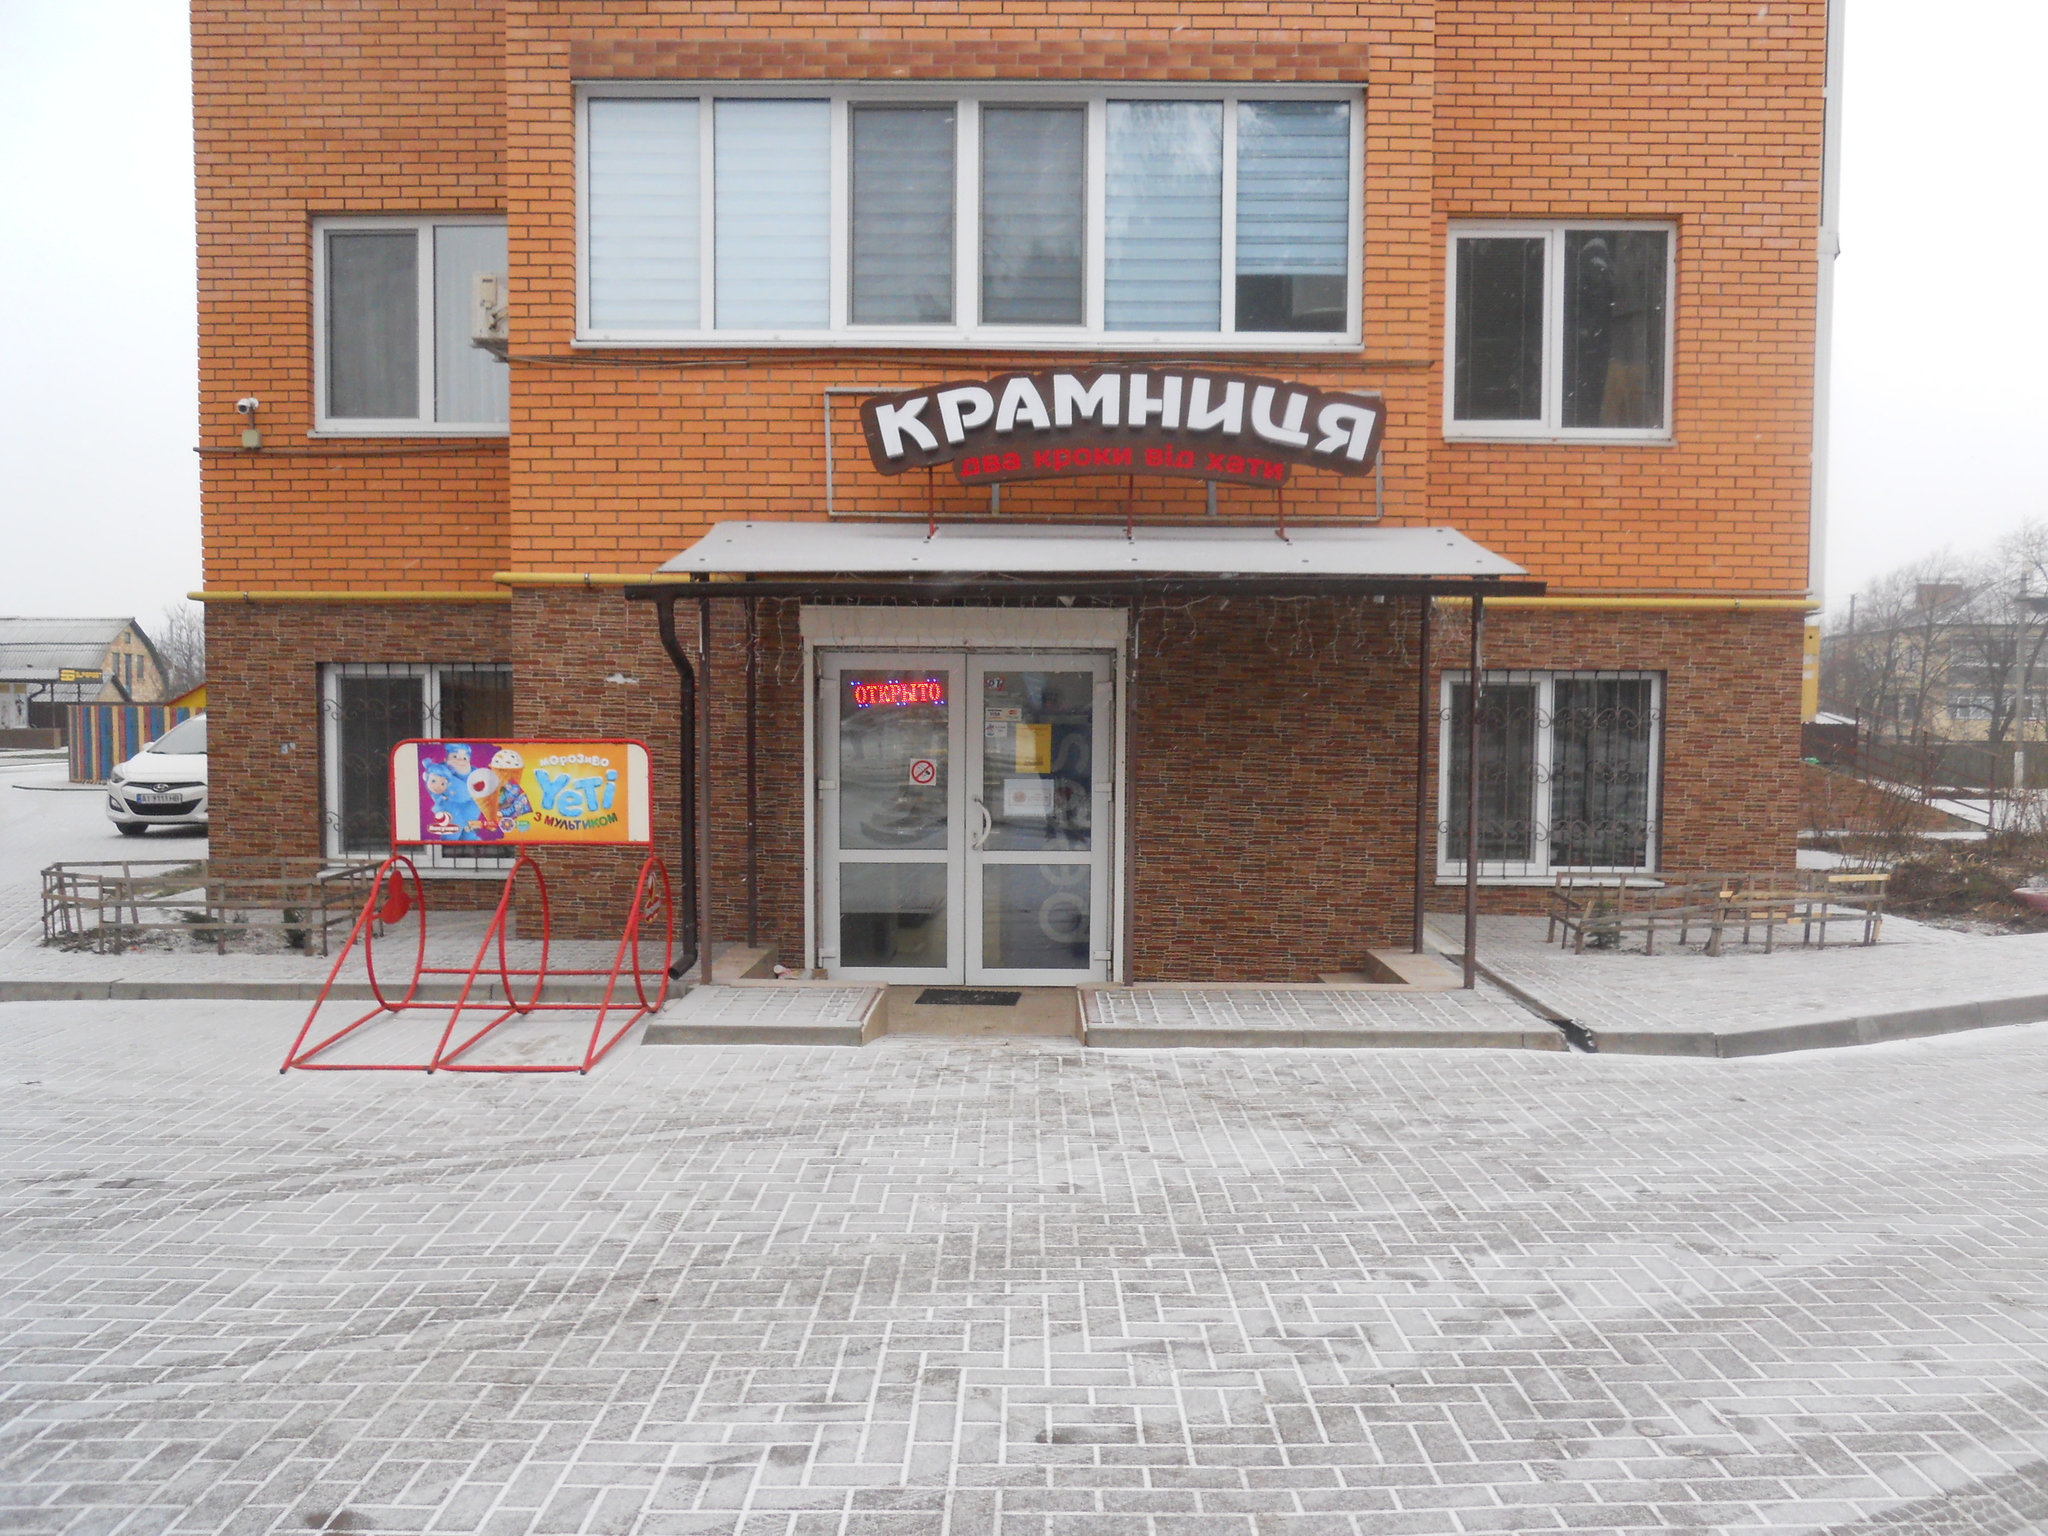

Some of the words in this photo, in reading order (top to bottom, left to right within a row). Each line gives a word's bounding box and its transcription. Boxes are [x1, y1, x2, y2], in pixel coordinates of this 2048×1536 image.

[874, 373, 1377, 461] КРАМНИЦЯ
[959, 451, 1021, 478] два
[1033, 445, 1132, 472] кроки
[1145, 444, 1196, 469] від
[1205, 452, 1285, 482] хати
[854, 683, 942, 704] ОТКРЫТО
[543, 812, 618, 831] МУЛЬТИКОМ
